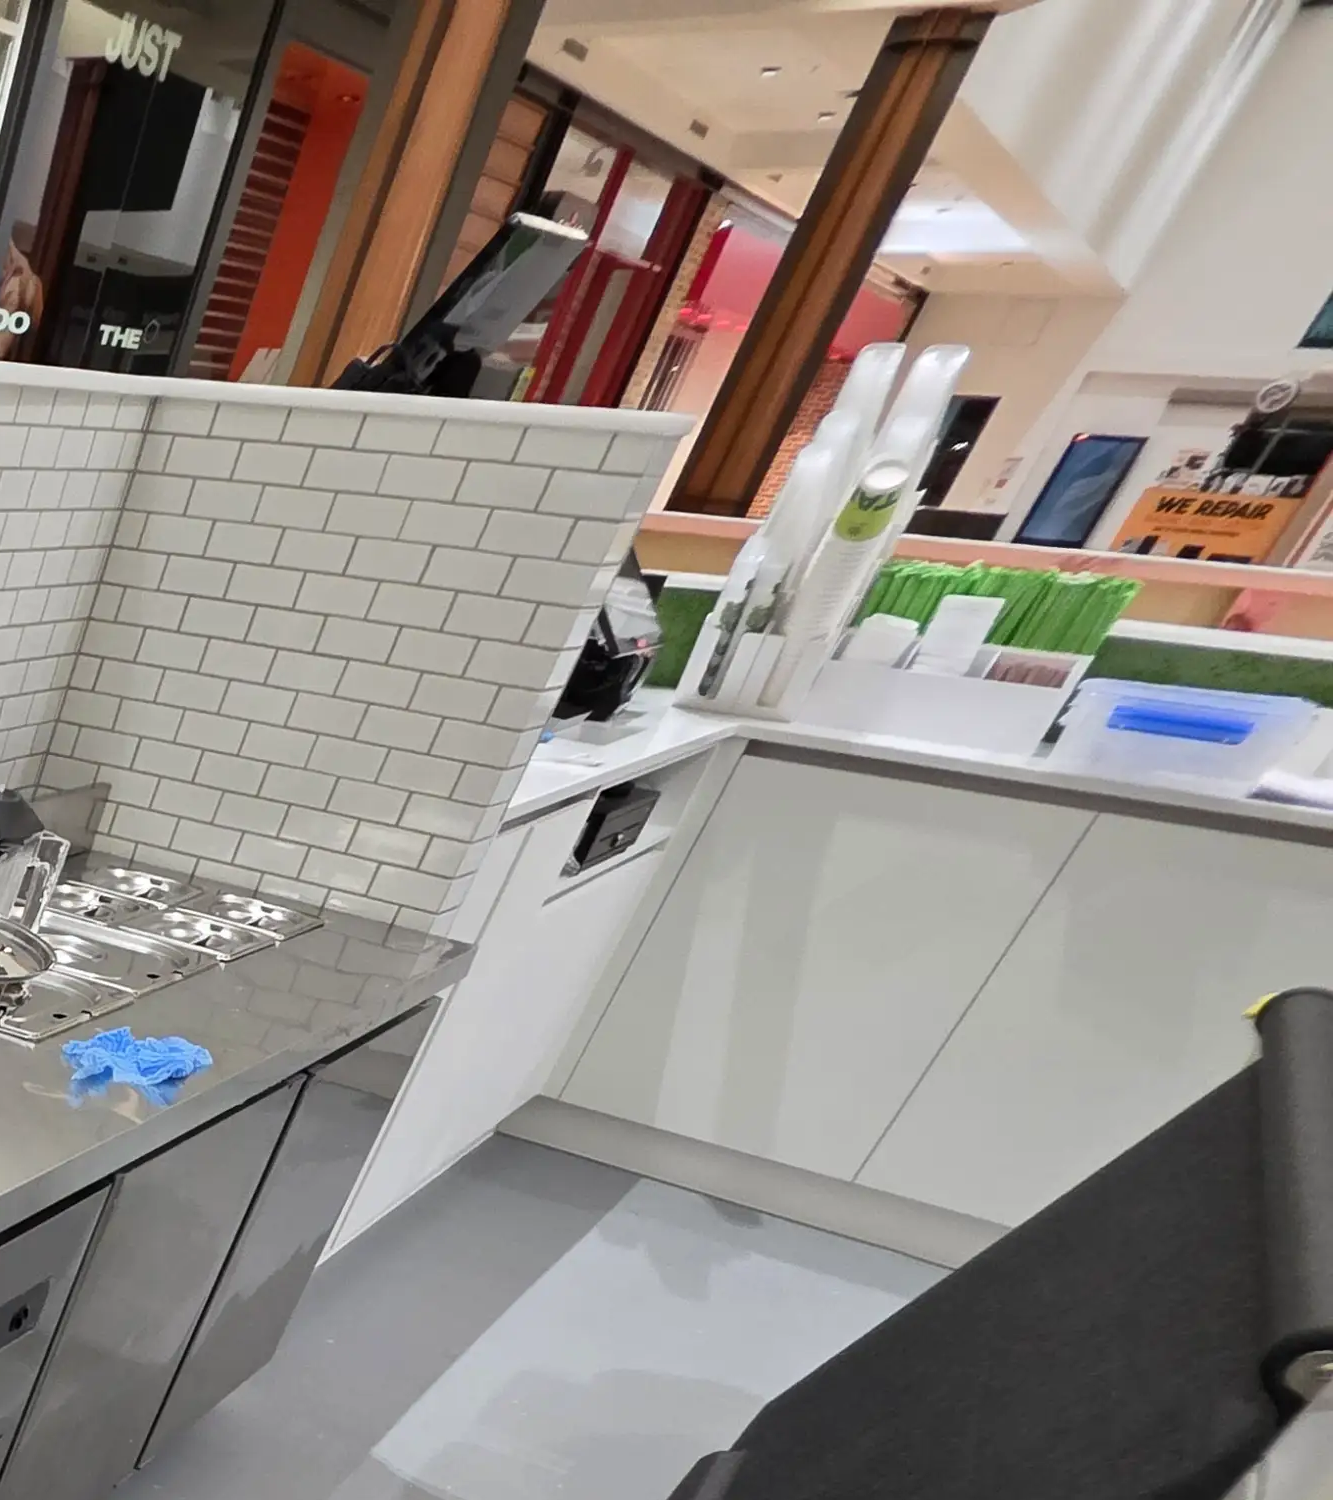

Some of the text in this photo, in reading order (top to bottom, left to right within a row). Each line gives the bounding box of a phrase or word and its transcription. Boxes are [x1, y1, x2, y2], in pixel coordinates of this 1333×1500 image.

[105, 12, 183, 83] JUST
[99, 324, 143, 350] THE
[1155, 496, 1274, 520] WE REPAIR
